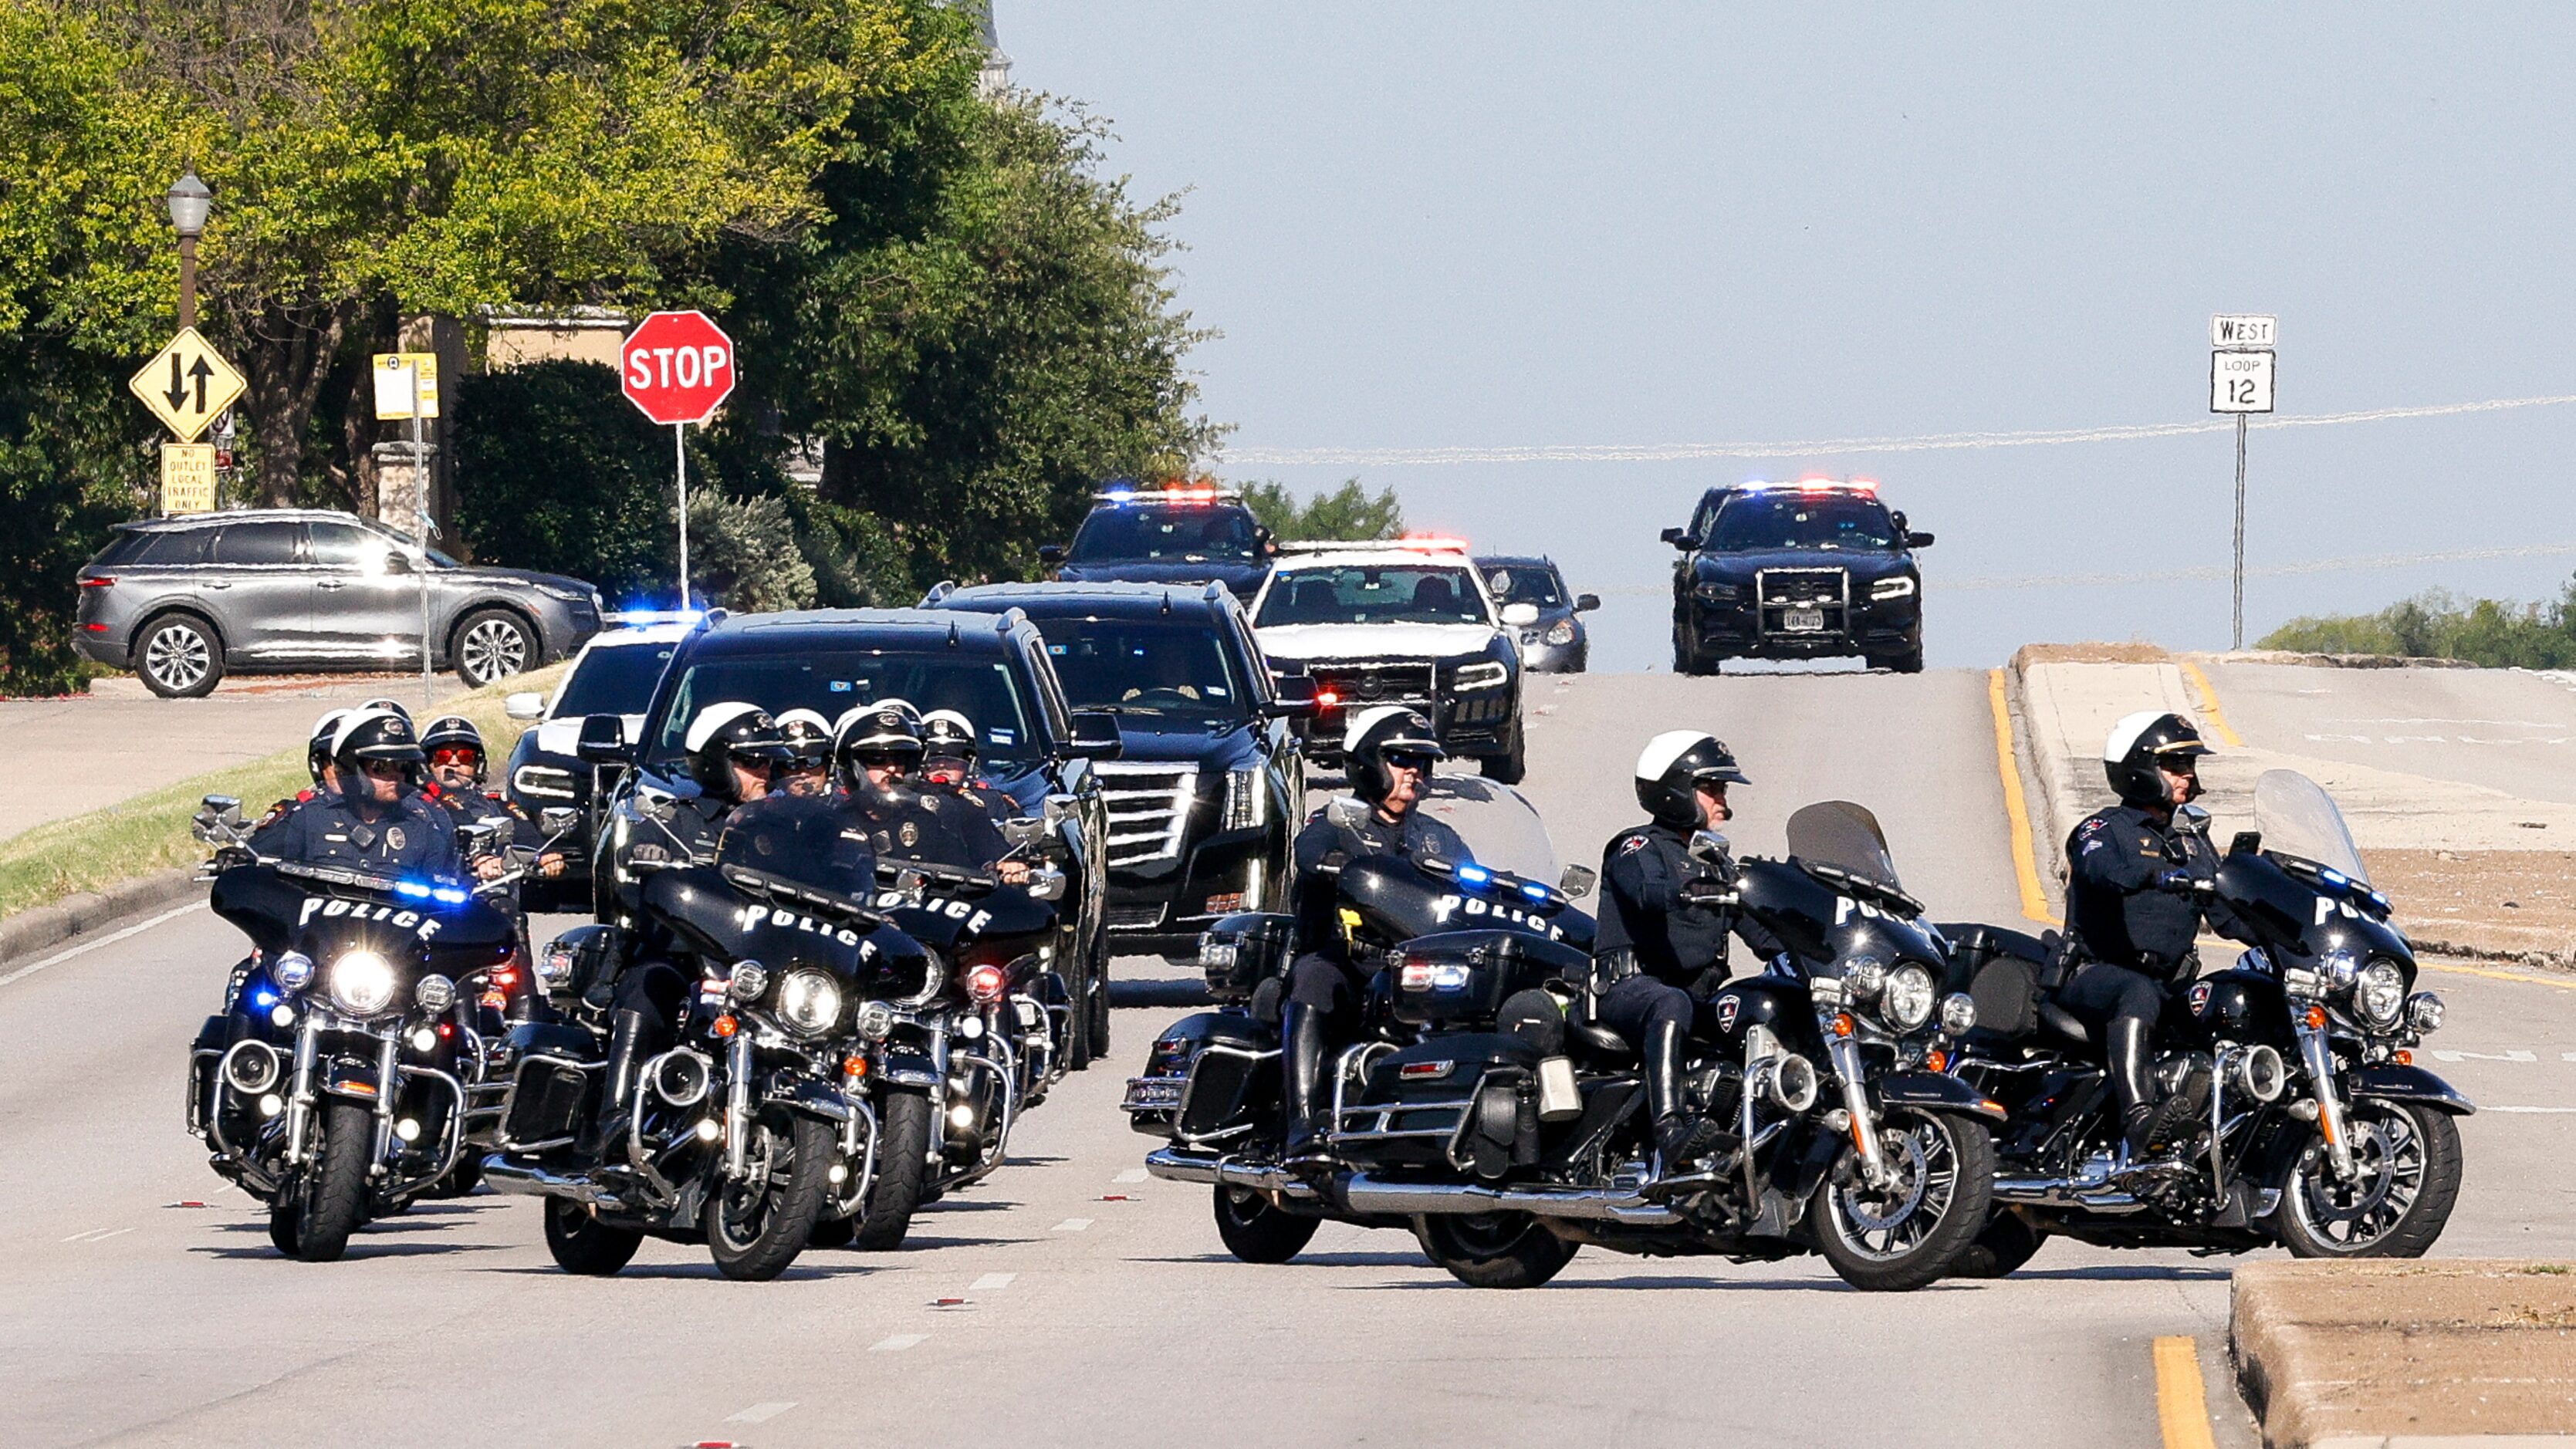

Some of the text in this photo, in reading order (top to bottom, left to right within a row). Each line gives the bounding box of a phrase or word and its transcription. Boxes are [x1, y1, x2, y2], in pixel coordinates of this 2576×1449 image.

[2220, 320, 2268, 340] WEST
[629, 345, 727, 390] STOP
[2224, 360, 2261, 371] LOOP
[2229, 379, 2256, 404] 12
[181, 449, 195, 458] NO
[170, 461, 206, 471] OUTLET
[171, 475, 203, 484] LOCAL
[167, 487, 209, 497] TRAFFIC
[175, 500, 200, 510] ONLY
[299, 898, 442, 941] POLICE
[866, 891, 992, 934] OLICE
[1436, 894, 1564, 941] POLICE
[742, 904, 877, 962] POLICE
